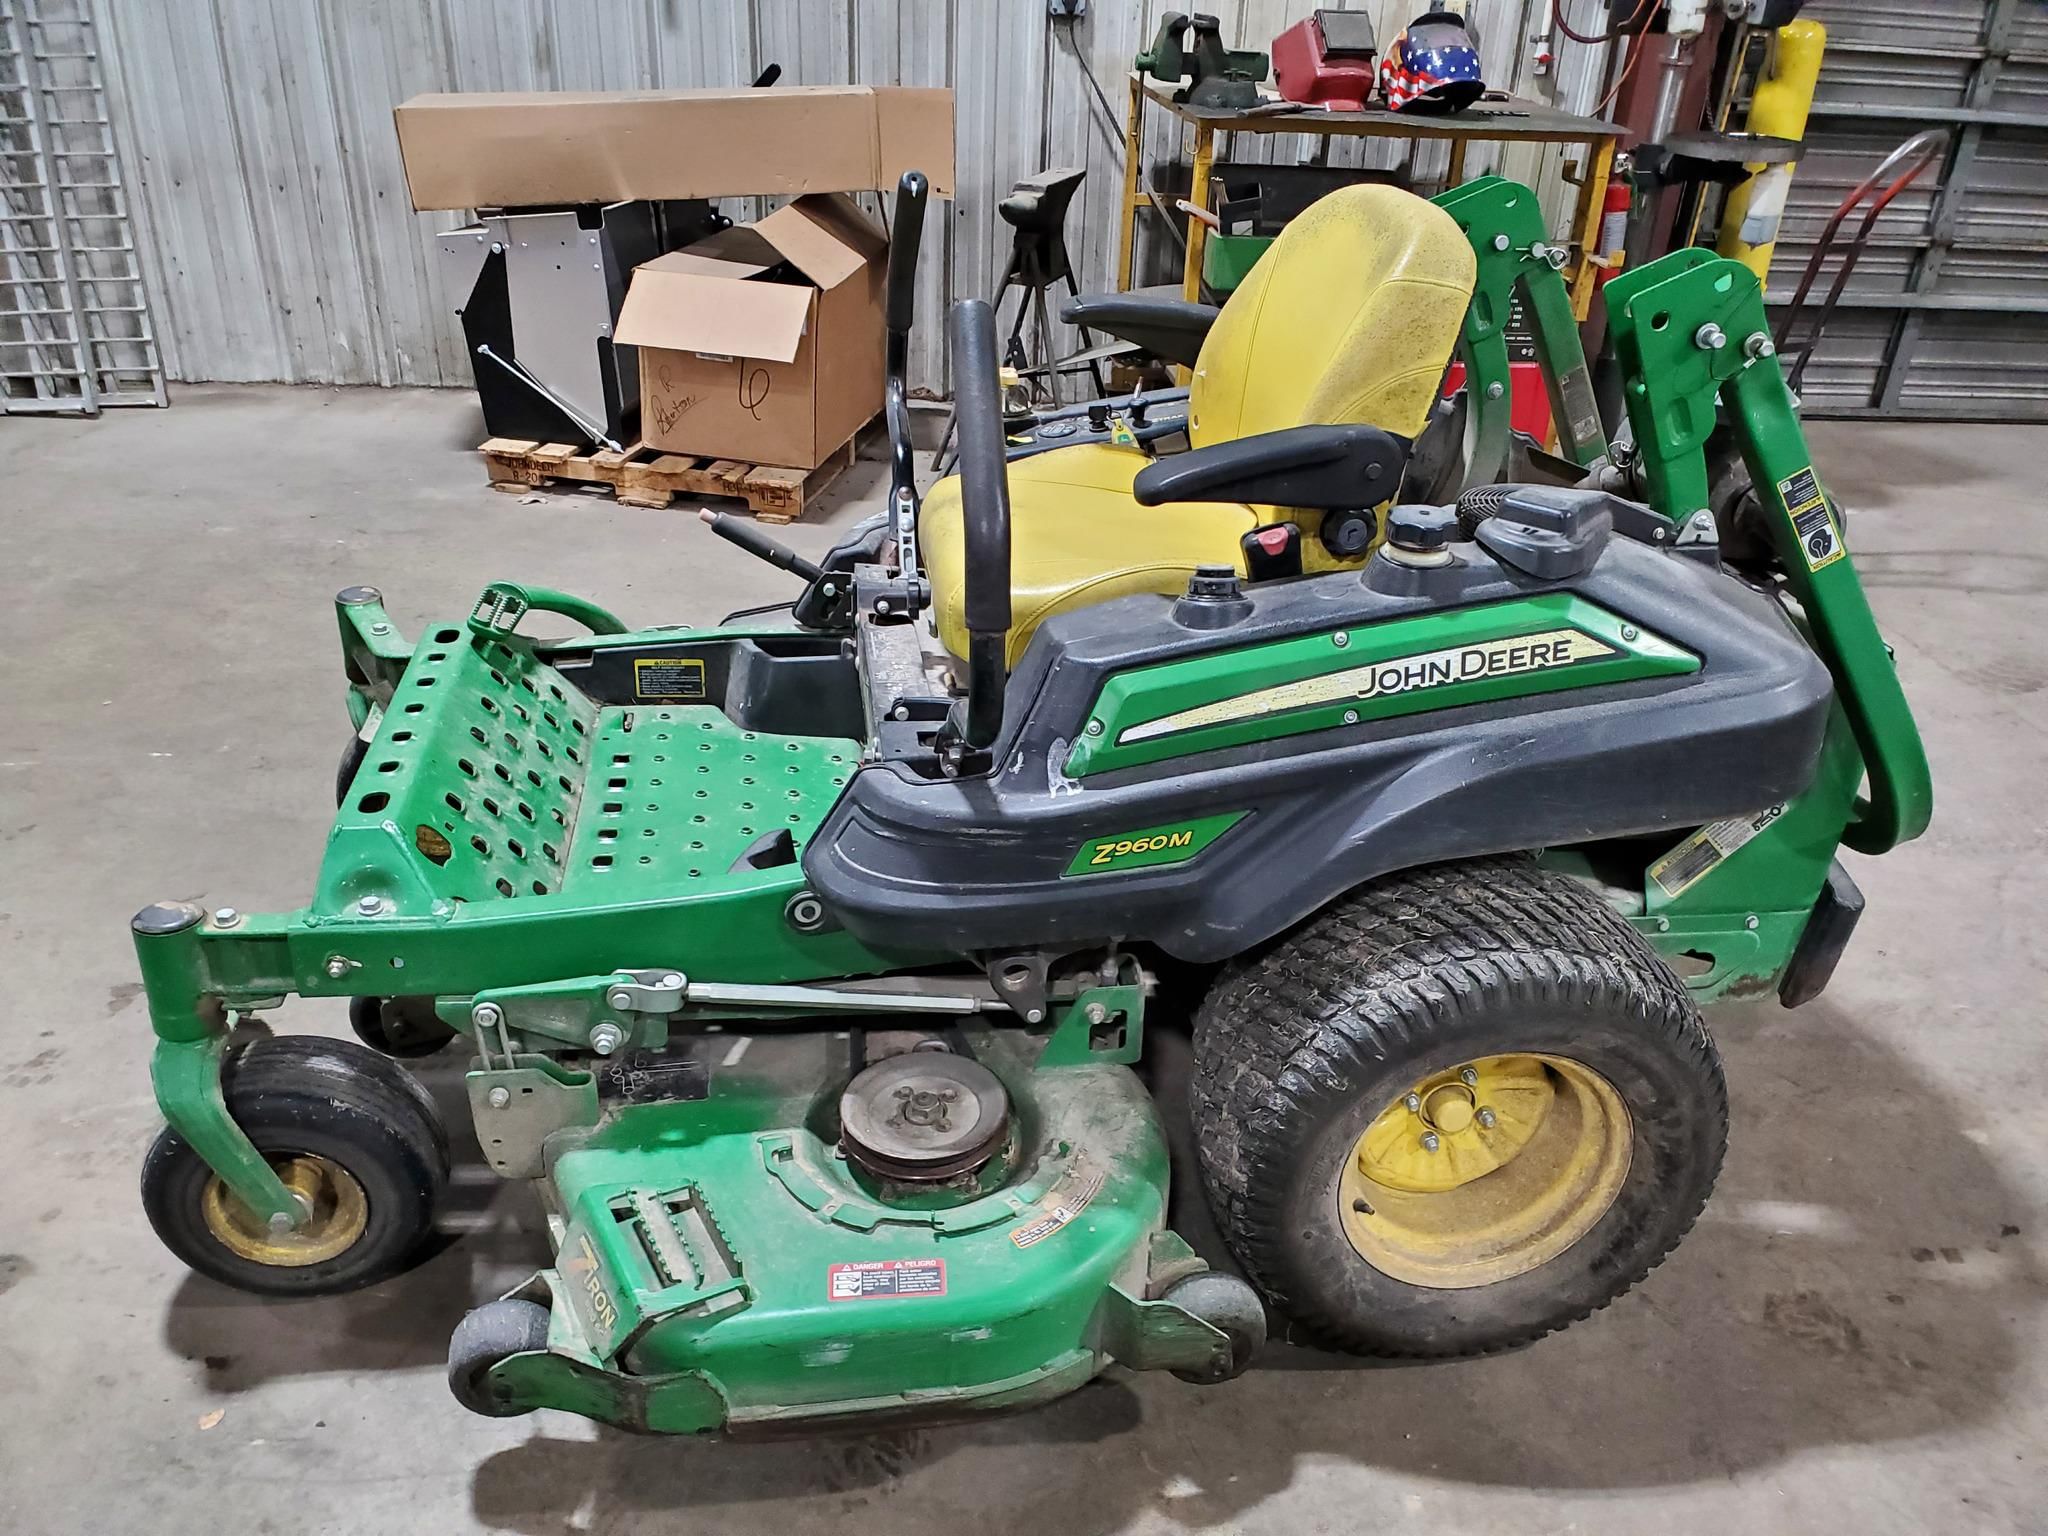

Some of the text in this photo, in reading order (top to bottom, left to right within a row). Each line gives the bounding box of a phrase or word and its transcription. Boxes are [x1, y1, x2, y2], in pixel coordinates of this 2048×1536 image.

[1358, 639, 1572, 696] JOHN DEERE
[1090, 830, 1193, 865] Z960M
[852, 1259, 937, 1270] DANGER PELIGRO
